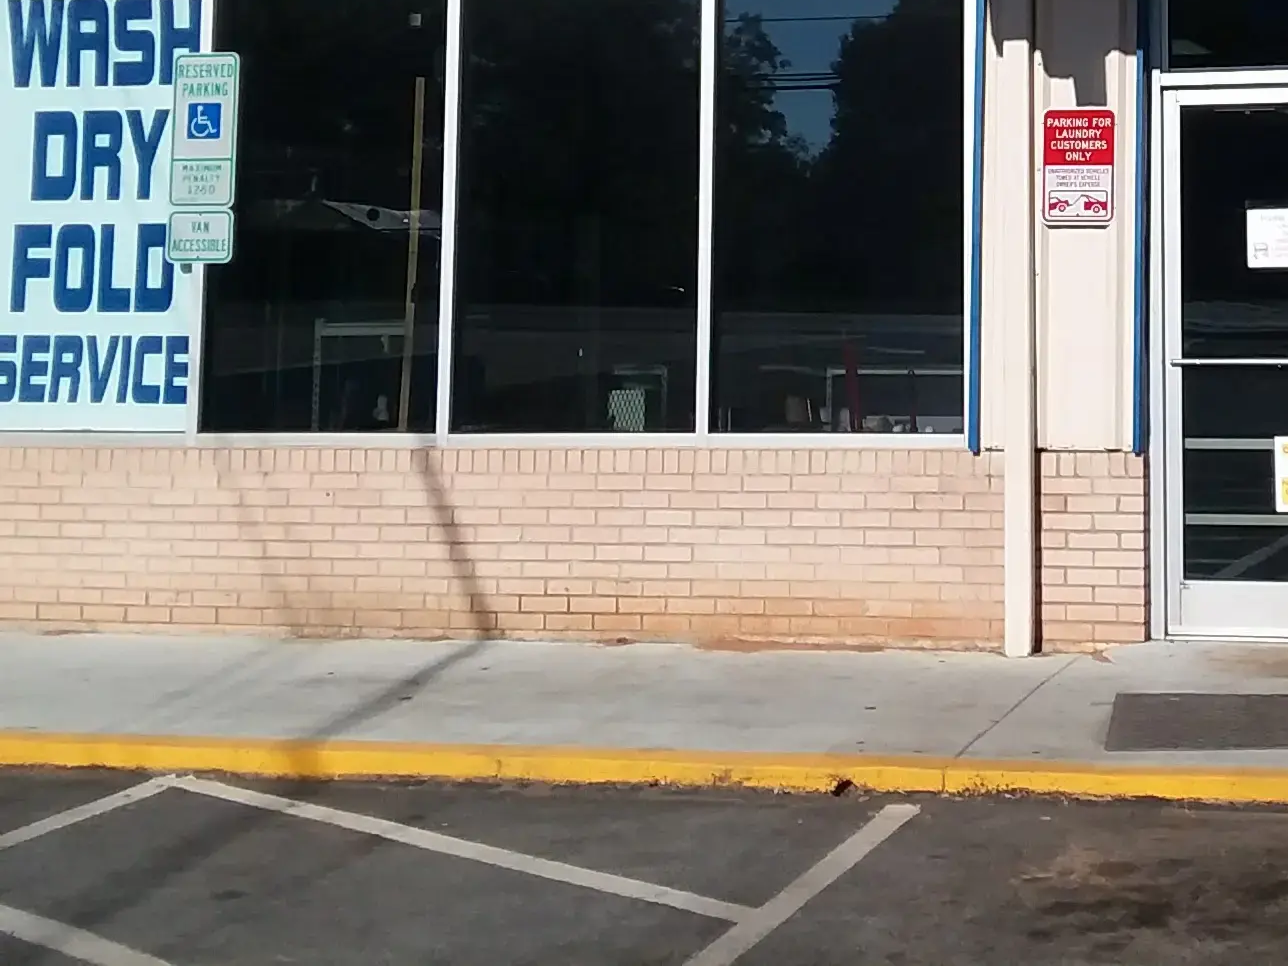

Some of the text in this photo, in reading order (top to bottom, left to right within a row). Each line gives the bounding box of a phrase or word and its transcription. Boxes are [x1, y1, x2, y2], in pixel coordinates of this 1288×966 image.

[178, 63, 233, 80] RESERVED
[182, 83, 228, 97] PARKING
[1046, 118, 1112, 127] PARKING FOR
[1055, 129, 1102, 138] LAUNDRY
[1050, 140, 1107, 149] CUSTOMERS
[30, 109, 170, 201] DRY
[1065, 152, 1092, 161] ONLY
[191, 221, 210, 233] VAN
[172, 237, 227, 253] ACCESSIBLE
[9, 223, 175, 313] FOLD
